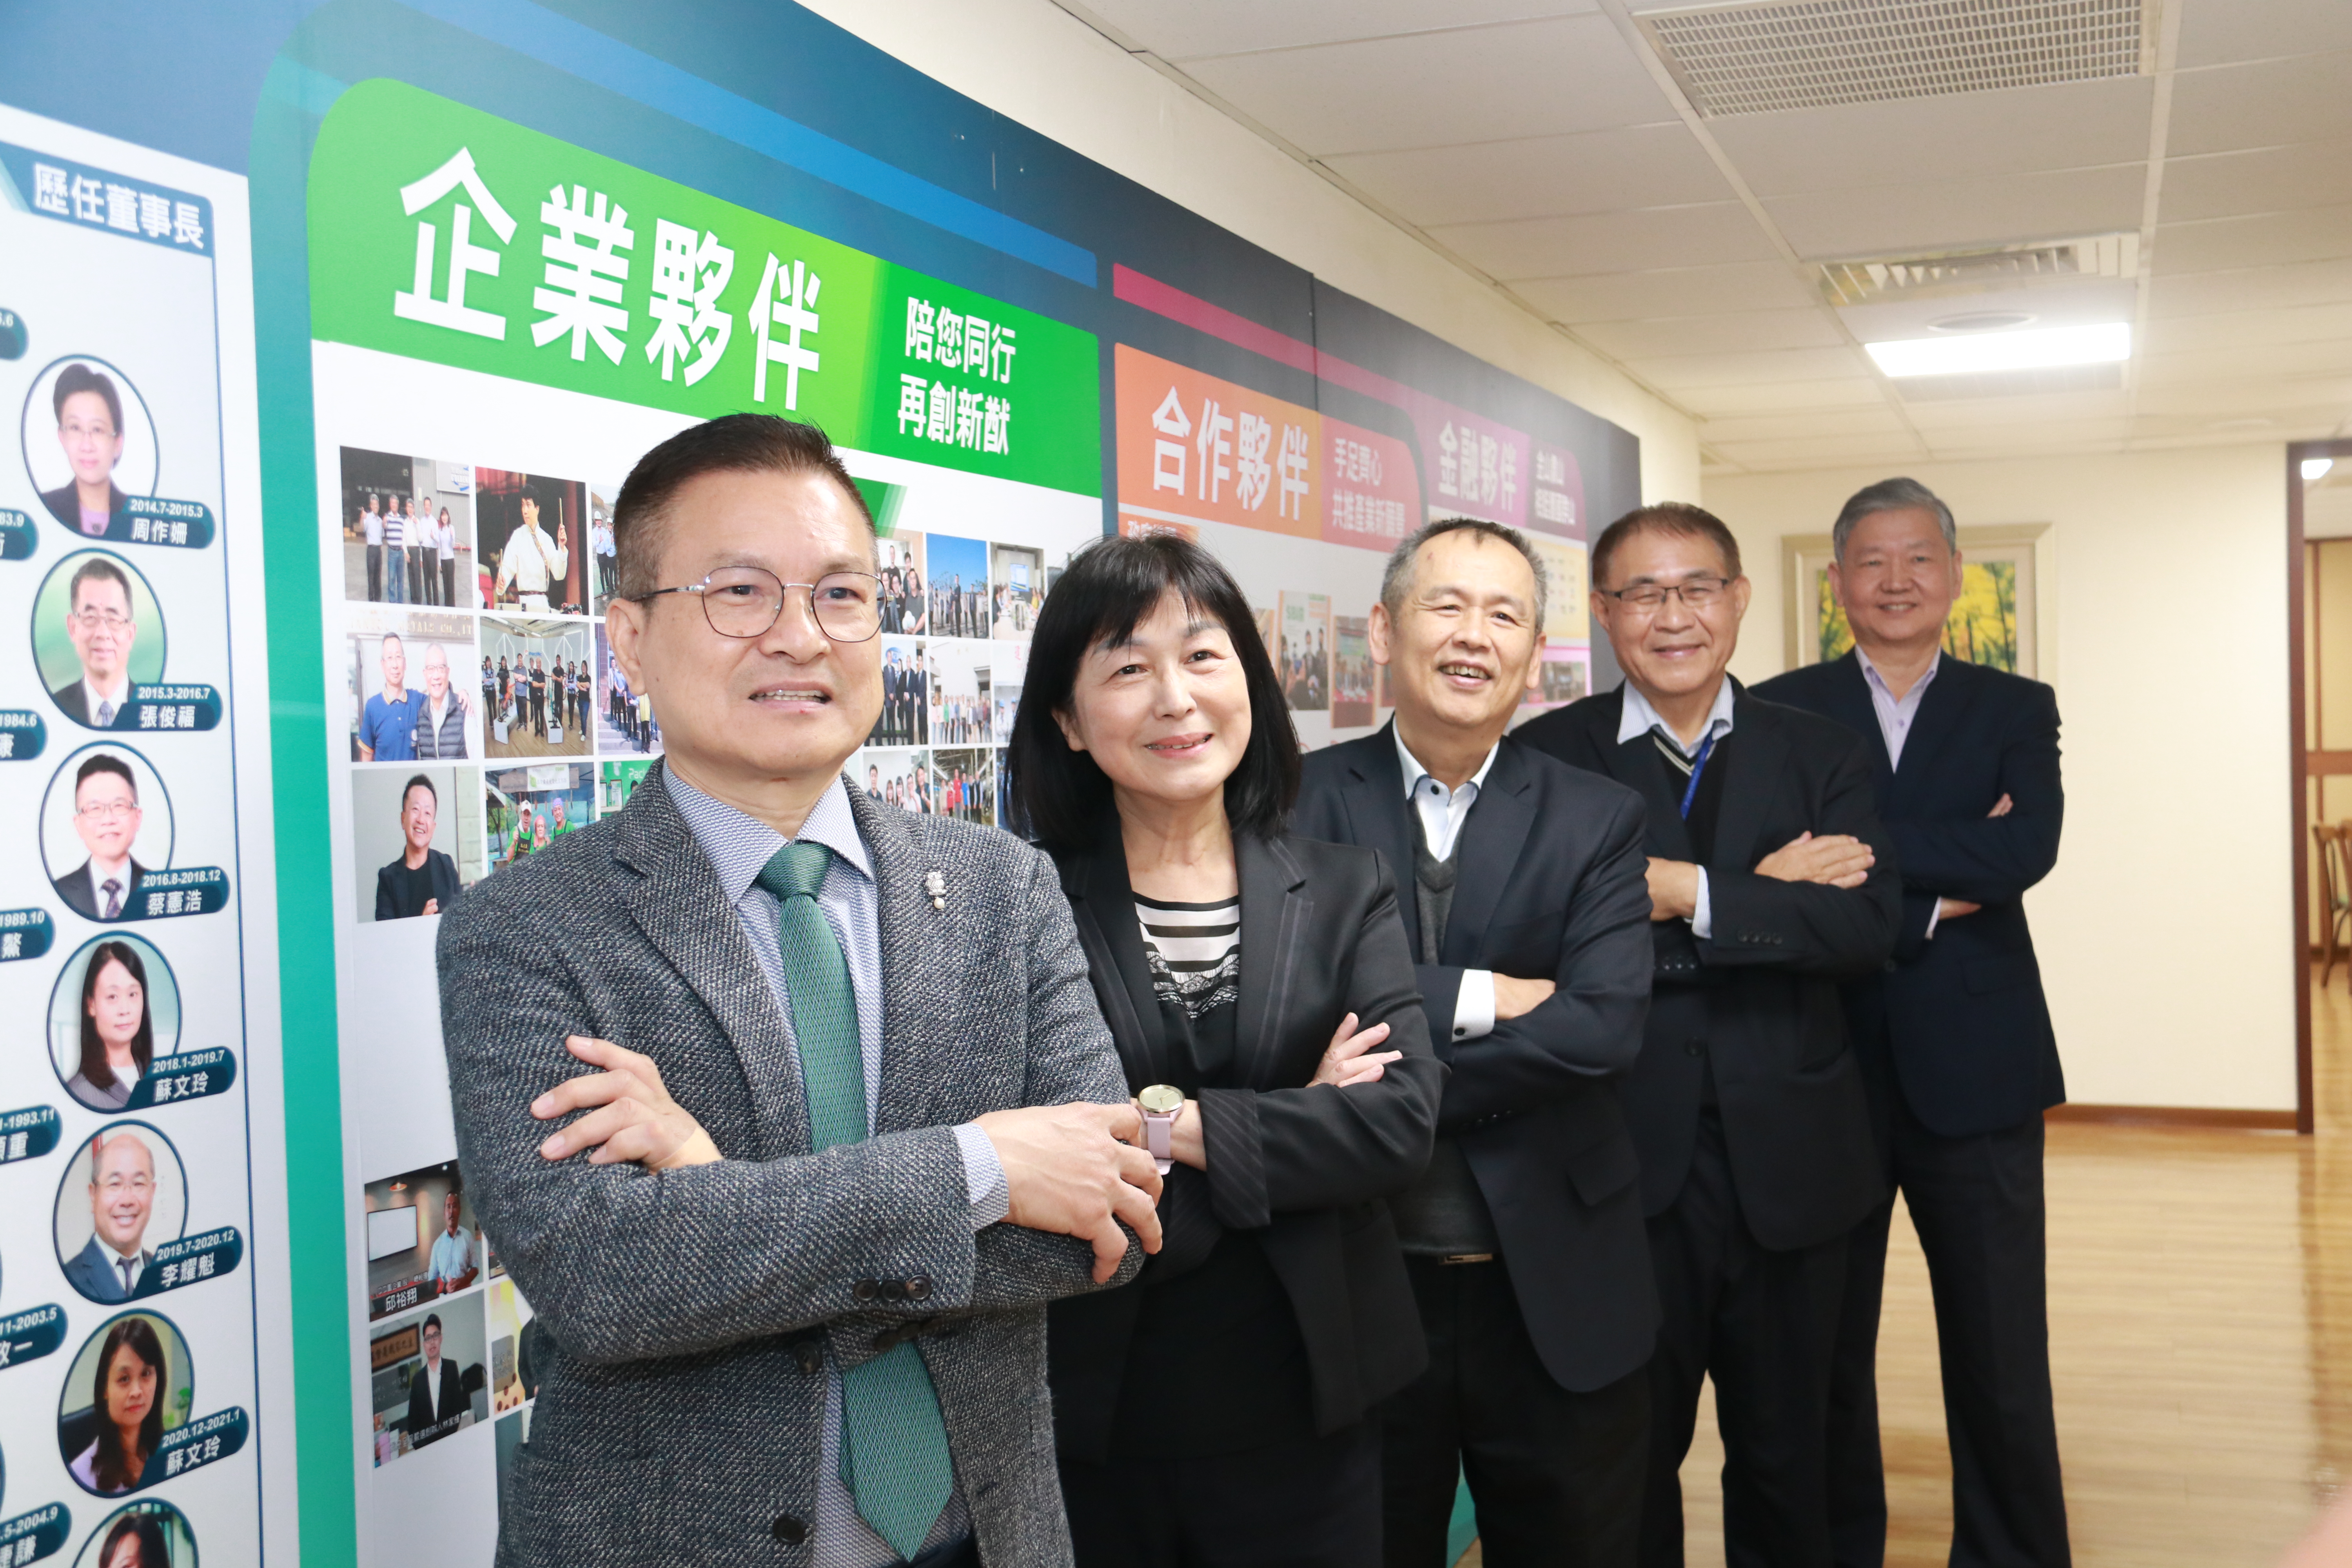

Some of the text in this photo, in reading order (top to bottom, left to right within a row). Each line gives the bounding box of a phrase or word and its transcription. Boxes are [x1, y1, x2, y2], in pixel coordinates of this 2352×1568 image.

[33, 162, 204, 249] 歷任董事長
[394, 146, 820, 410] 企業夥伴
[905, 296, 1016, 384] 陪您同行
[898, 373, 1011, 456] 再創新猷
[1152, 385, 1309, 521] 合作夥伴
[130, 499, 203, 518] 2014.7-2015.3
[138, 687, 211, 699] 2015.3-2016.7
[140, 705, 196, 728] 張俊福
[143, 869, 221, 887] 2016.8-2018.12
[147, 890, 202, 916] 蔡憲浩
[153, 1050, 225, 1074] 2018.1-2019.7
[155, 1071, 209, 1102] 蘇文玲
[157, 1229, 235, 1261] 2019.7-2020.12
[161, 1252, 215, 1288] 李耀魁
[385, 1287, 417, 1312] 邱裕翔
[162, 1408, 240, 1447] 2020.12-2021.1
[165, 1435, 221, 1476] 蘇文玲
